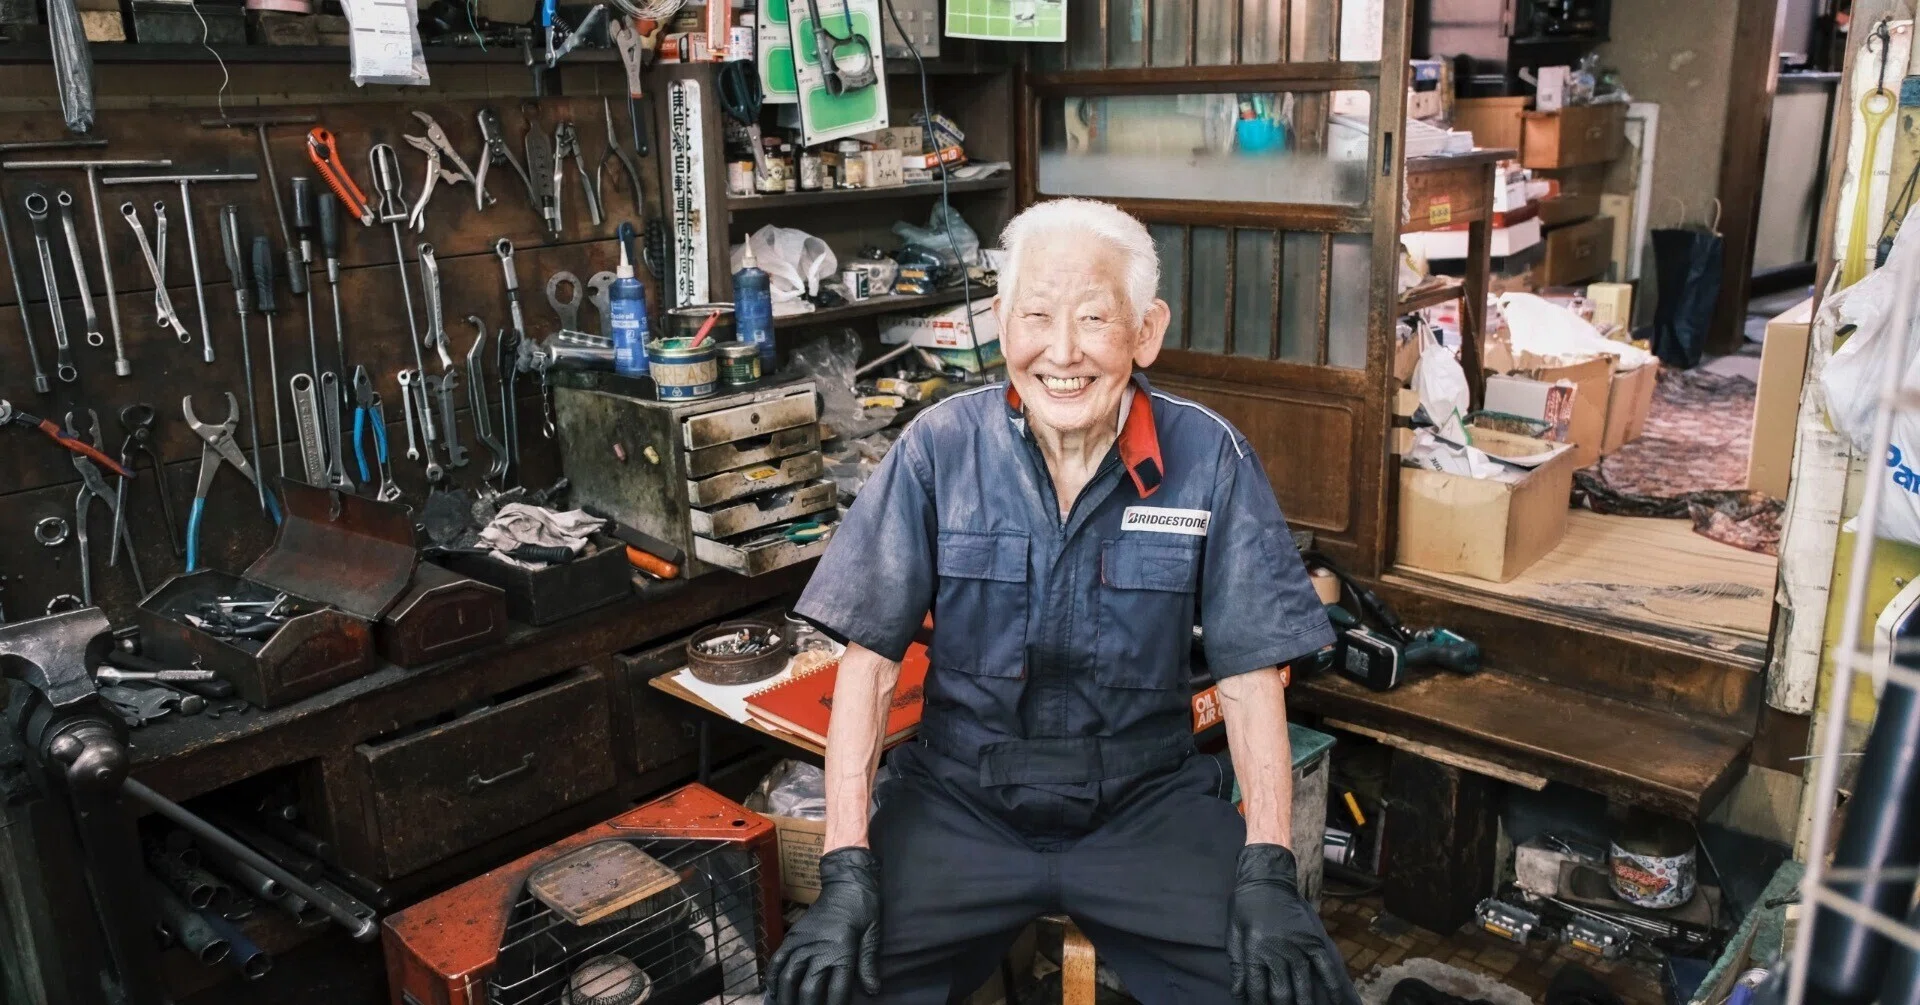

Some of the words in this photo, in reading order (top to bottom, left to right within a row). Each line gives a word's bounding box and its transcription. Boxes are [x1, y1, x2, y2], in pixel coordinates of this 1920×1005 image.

[1127, 512, 1207, 529] BRIDGESTONE
[1195, 693, 1214, 713] OIL
[1197, 708, 1216, 728] AIR
